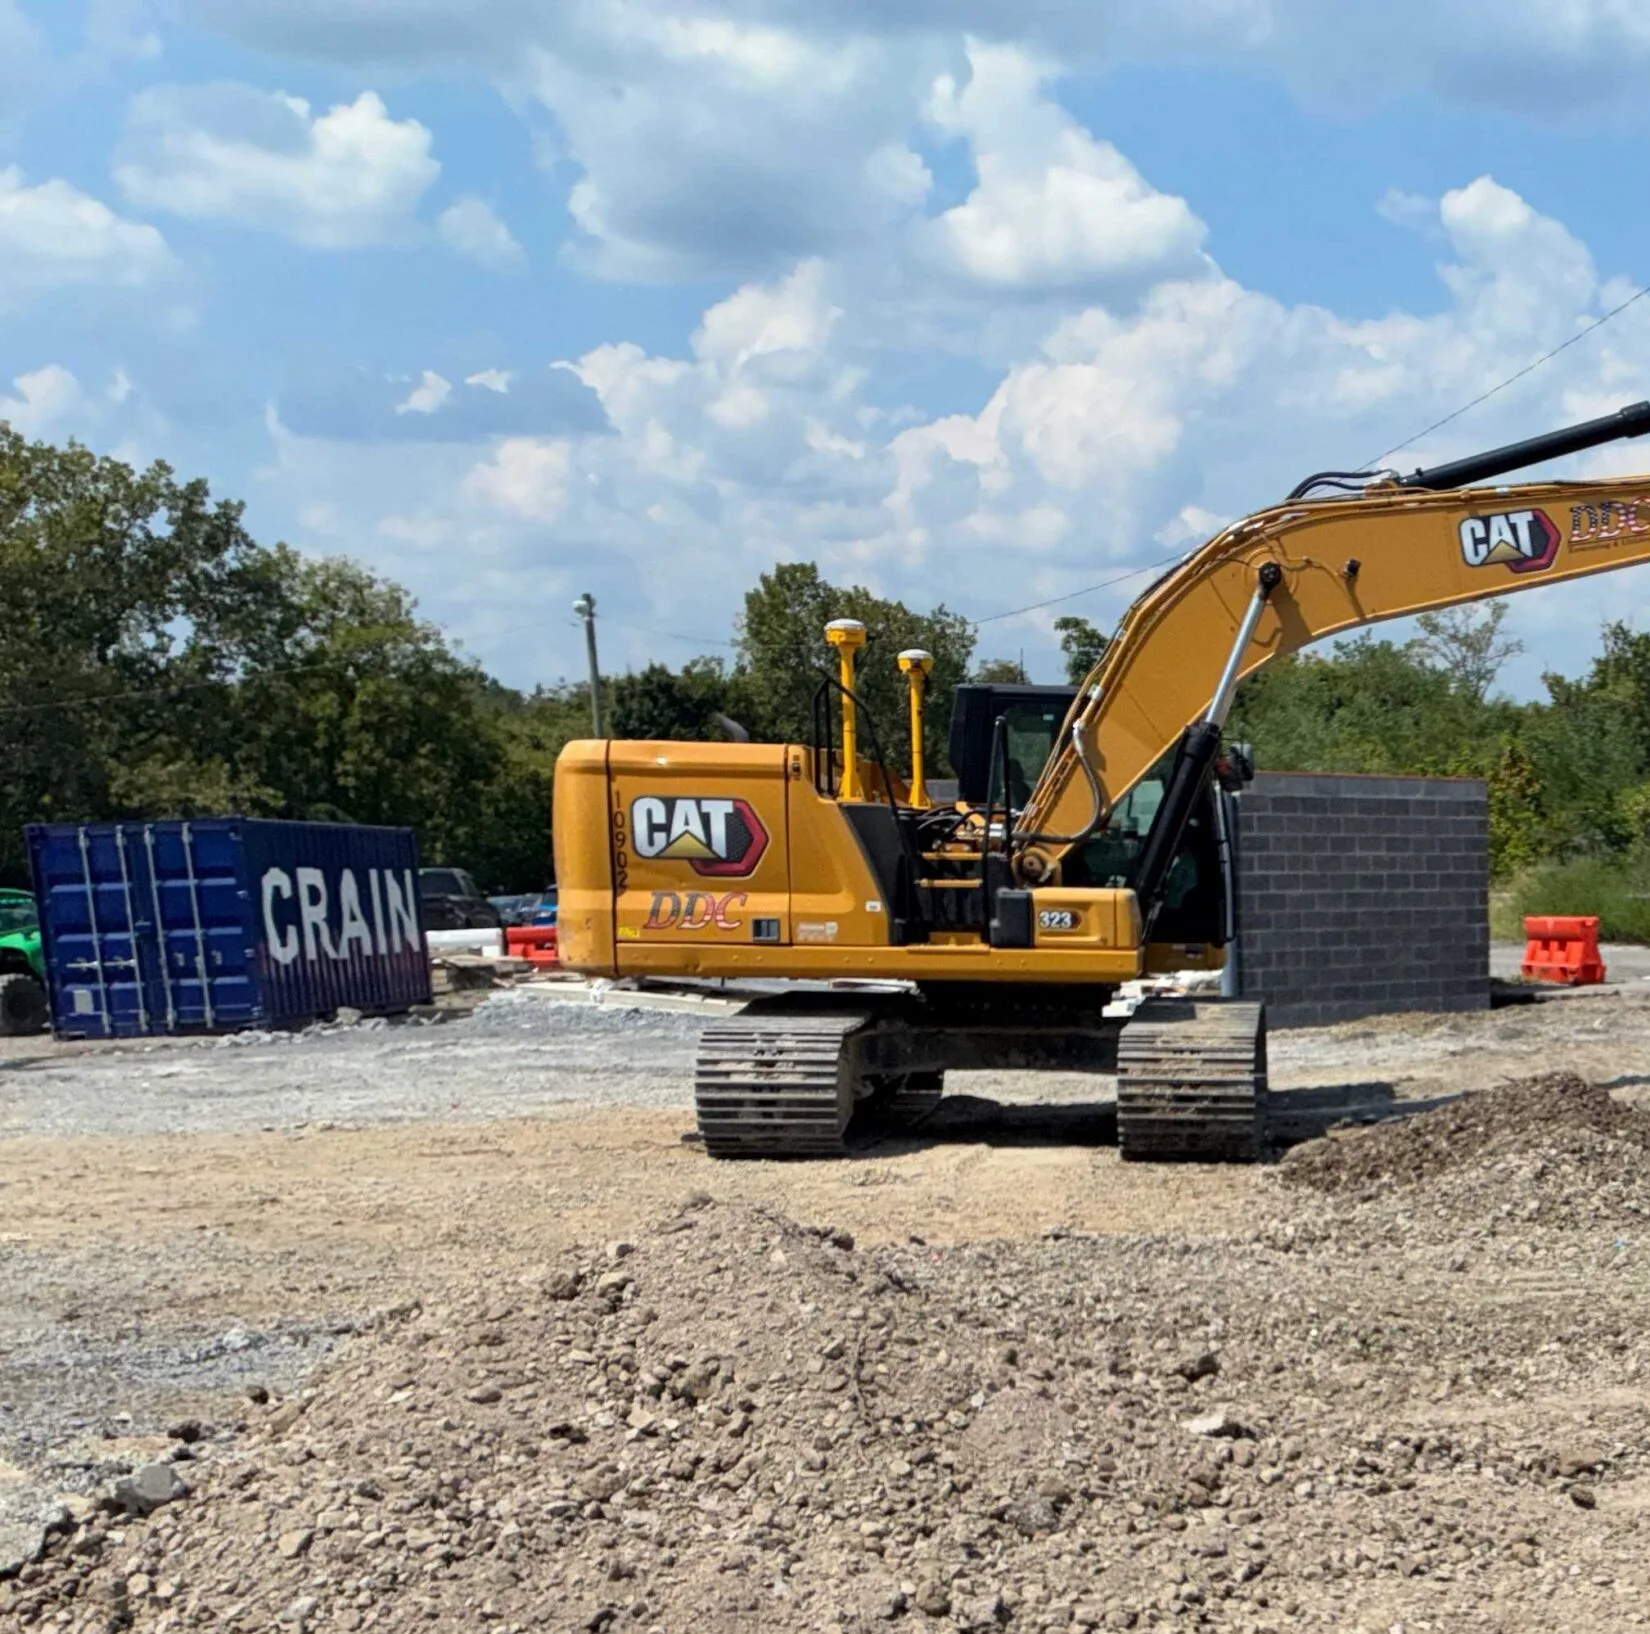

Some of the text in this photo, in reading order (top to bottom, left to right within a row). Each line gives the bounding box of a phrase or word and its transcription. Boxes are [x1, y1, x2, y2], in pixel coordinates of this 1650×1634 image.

[1460, 510, 1534, 565] CAT
[613, 790, 629, 889] 10902
[632, 797, 734, 859] CAT
[261, 866, 420, 965] CRAIN
[642, 891, 748, 931] DDC
[1039, 910, 1072, 929] 323
